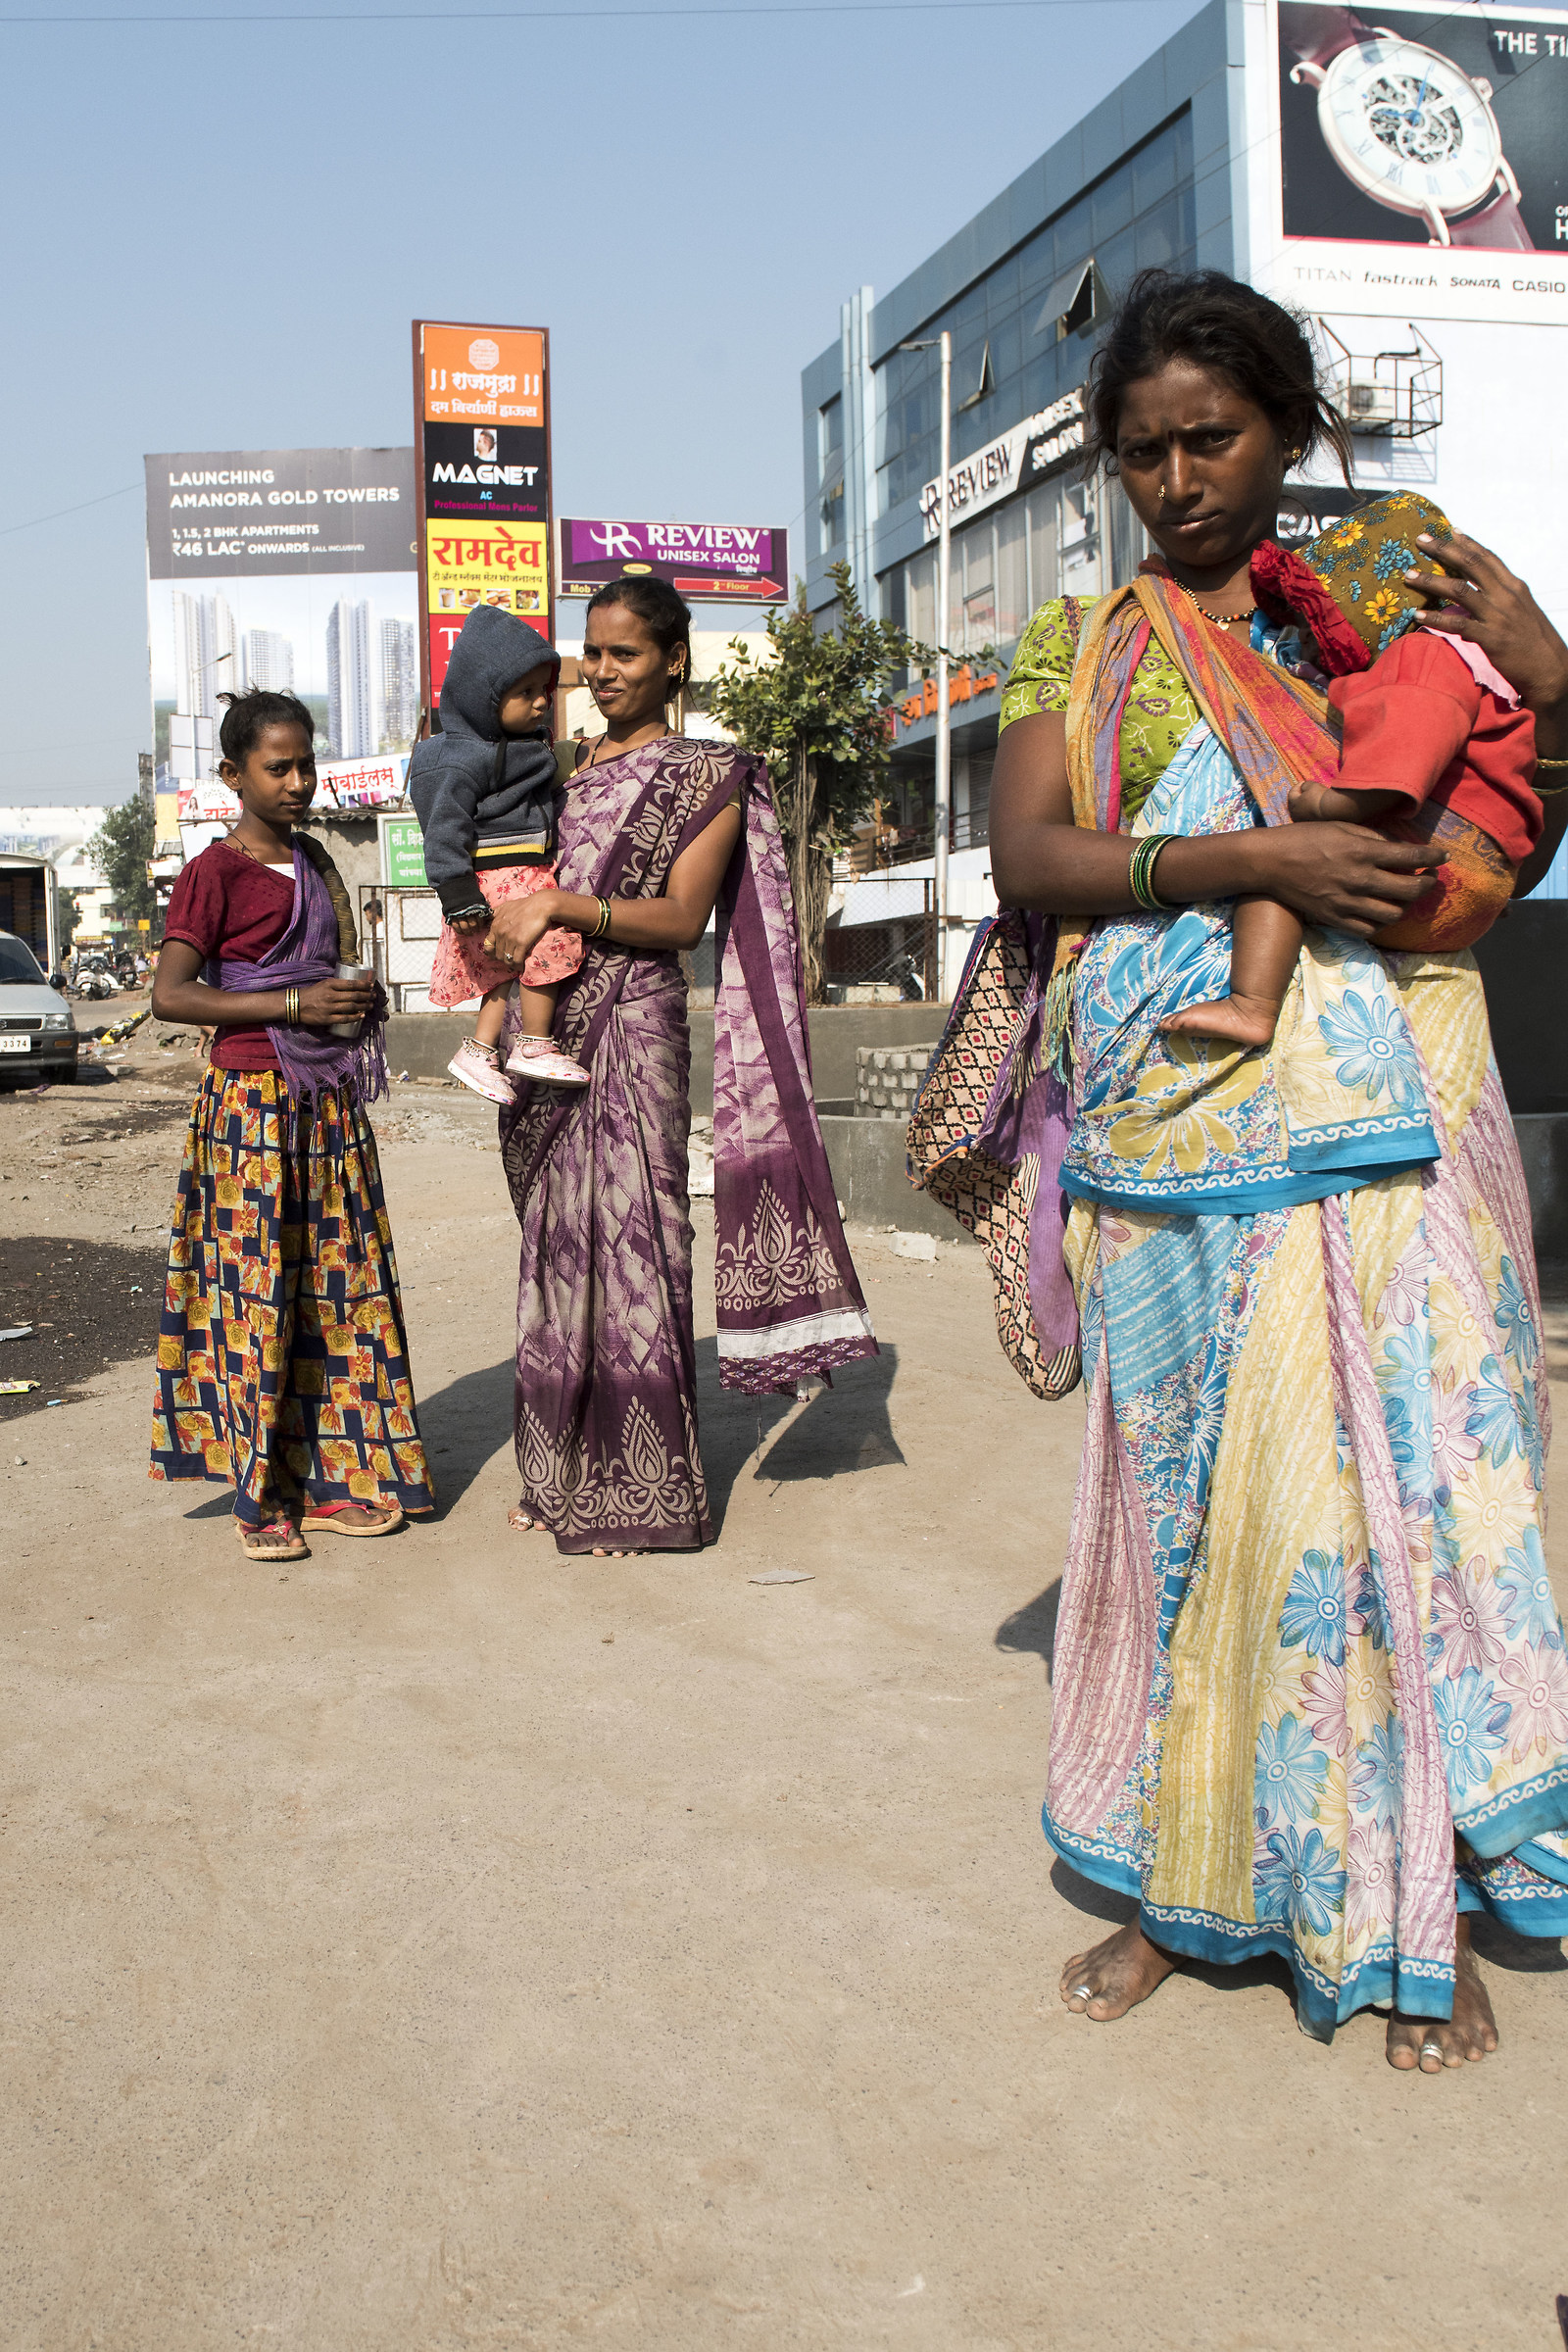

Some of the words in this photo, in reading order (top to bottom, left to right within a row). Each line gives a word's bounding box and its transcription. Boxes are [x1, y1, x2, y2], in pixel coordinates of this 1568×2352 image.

[1494, 30, 1538, 55] THE
[1544, 34, 1568, 58] TI
[1294, 267, 1351, 281] TITAN
[1364, 270, 1439, 287] fastrack
[1450, 275, 1500, 289] SONATA
[1512, 279, 1566, 293] CASIO
[452, 371, 516, 398] राजमुद्रा
[170, 469, 274, 486] LAUNCHING
[432, 462, 539, 486] MAGNET
[170, 492, 263, 508] AMANORA
[268, 490, 318, 506] GOLD
[323, 487, 400, 504] TOWERS
[480, 491, 493, 500] AC
[203, 526, 212, 538] 2
[214, 525, 238, 538] BHK
[240, 524, 319, 537] APARTMENTS
[646, 524, 760, 551] REVIEW
[247, 542, 310, 555] ONWARDS
[431, 526, 542, 571] रामदेव
[657, 549, 710, 563] UNISEX
[712, 551, 760, 564] SALON
[570, 583, 591, 593] Mob
